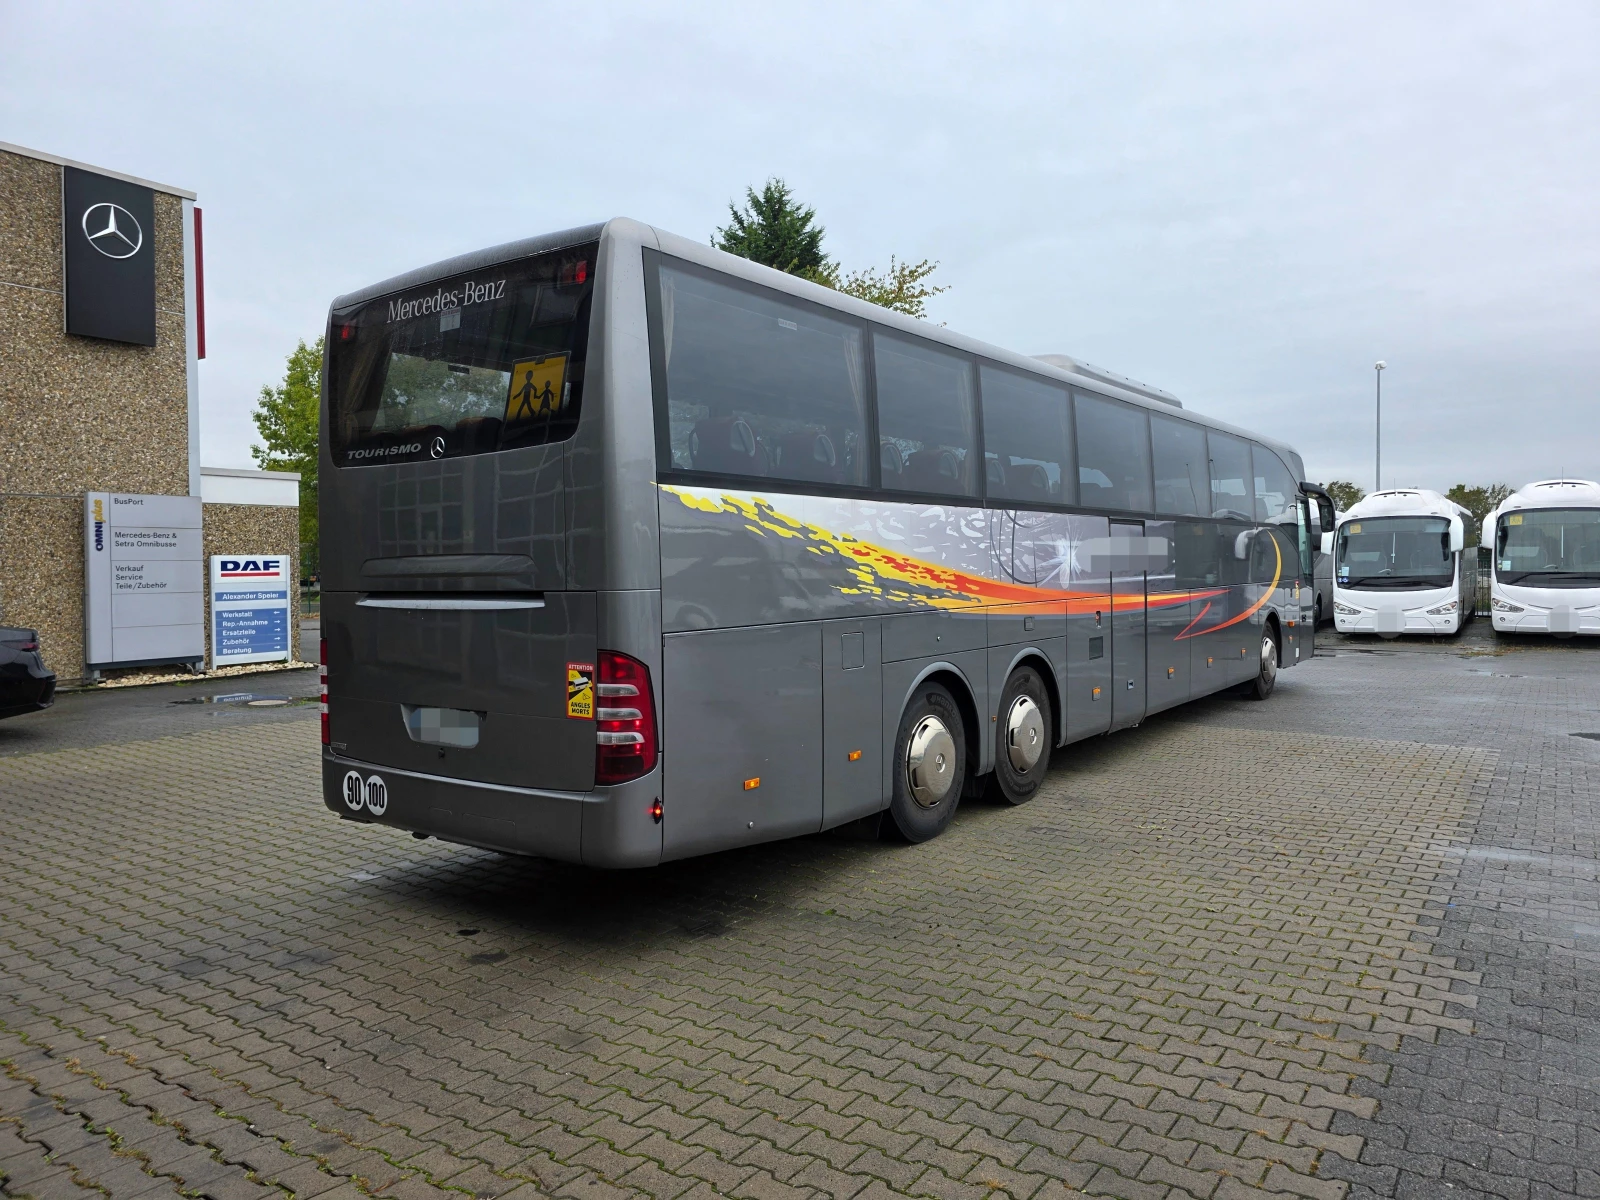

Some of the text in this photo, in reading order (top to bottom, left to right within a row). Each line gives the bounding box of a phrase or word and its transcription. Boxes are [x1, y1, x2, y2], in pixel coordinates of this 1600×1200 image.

[387, 280, 506, 324] Mercedes-Benz
[347, 443, 422, 459] TOURISMO
[220, 560, 280, 572] DAF
[115, 582, 167, 590] Teile/Zubehör
[257, 592, 279, 600] Speier
[222, 619, 268, 628] Rep.-Annahme
[222, 647, 252, 655] Beratung
[571, 701, 591, 709] ANGLES
[347, 774, 361, 806] 90
[367, 781, 385, 809] 100
